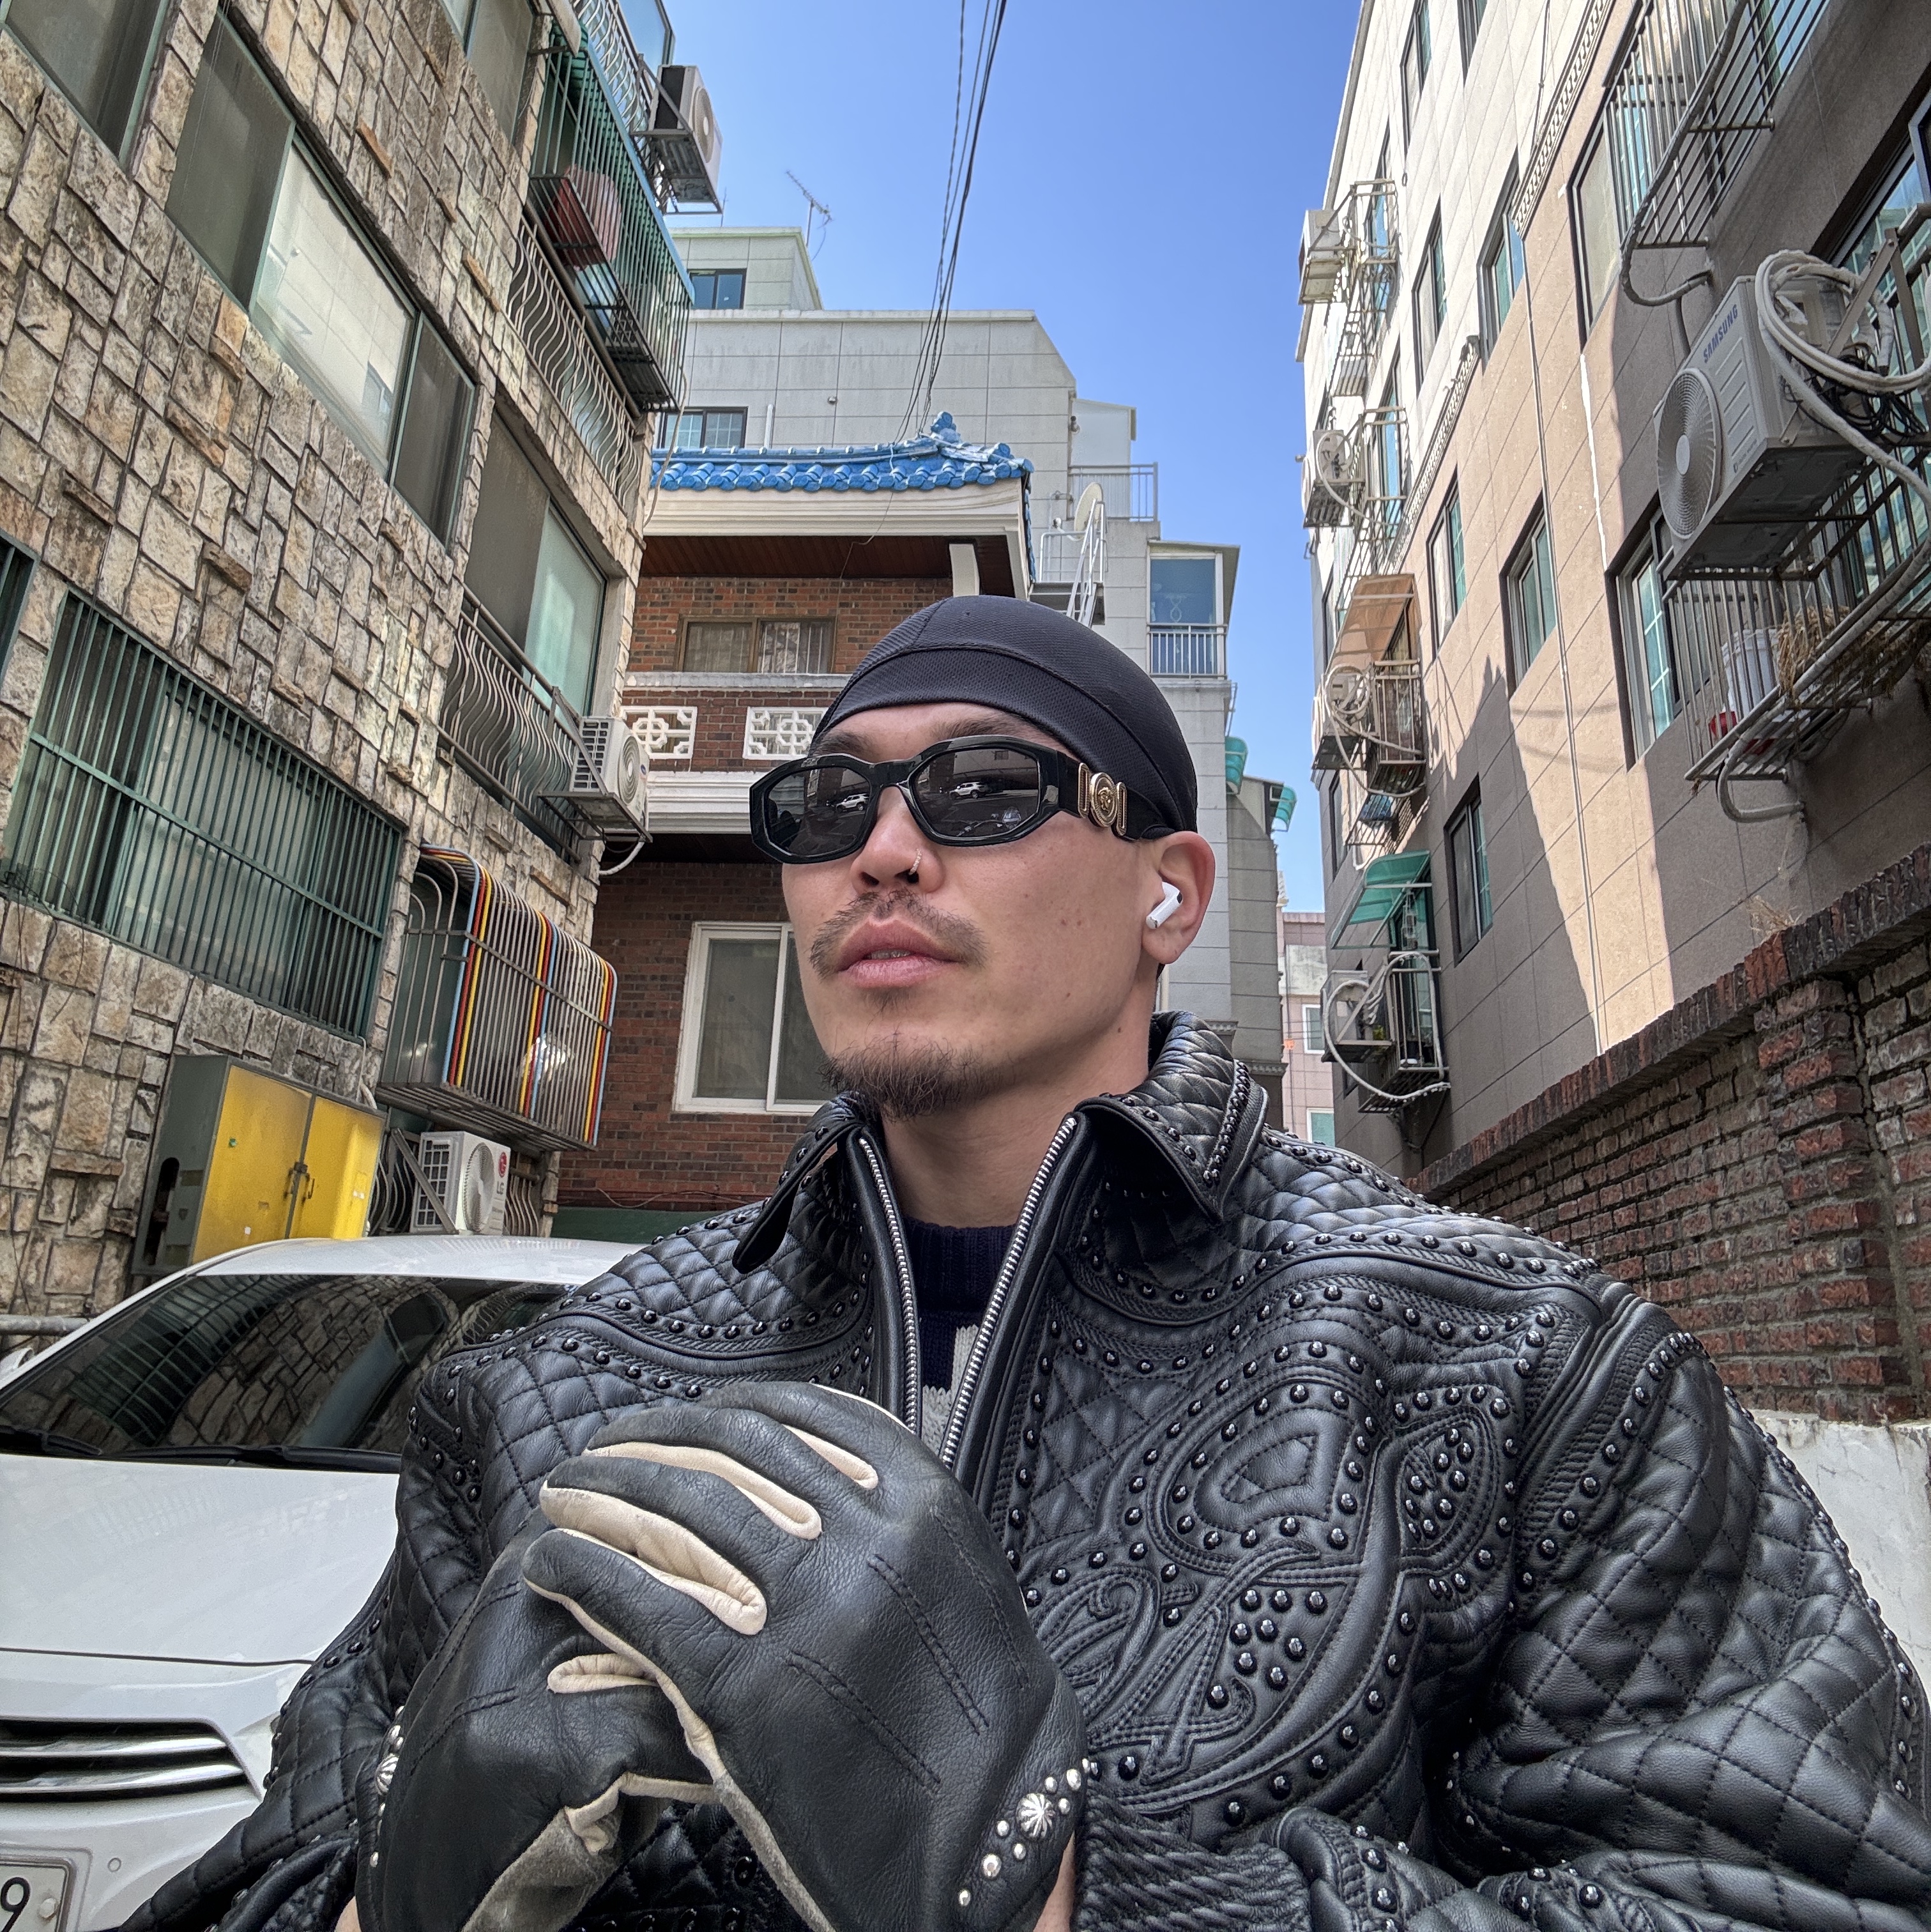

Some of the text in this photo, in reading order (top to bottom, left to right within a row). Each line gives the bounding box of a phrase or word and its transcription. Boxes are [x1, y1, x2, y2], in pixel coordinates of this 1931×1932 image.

[1703, 305, 1738, 364] SAMSUNG
[496, 1181, 505, 1195] LG
[1, 1876, 31, 1931] 9
